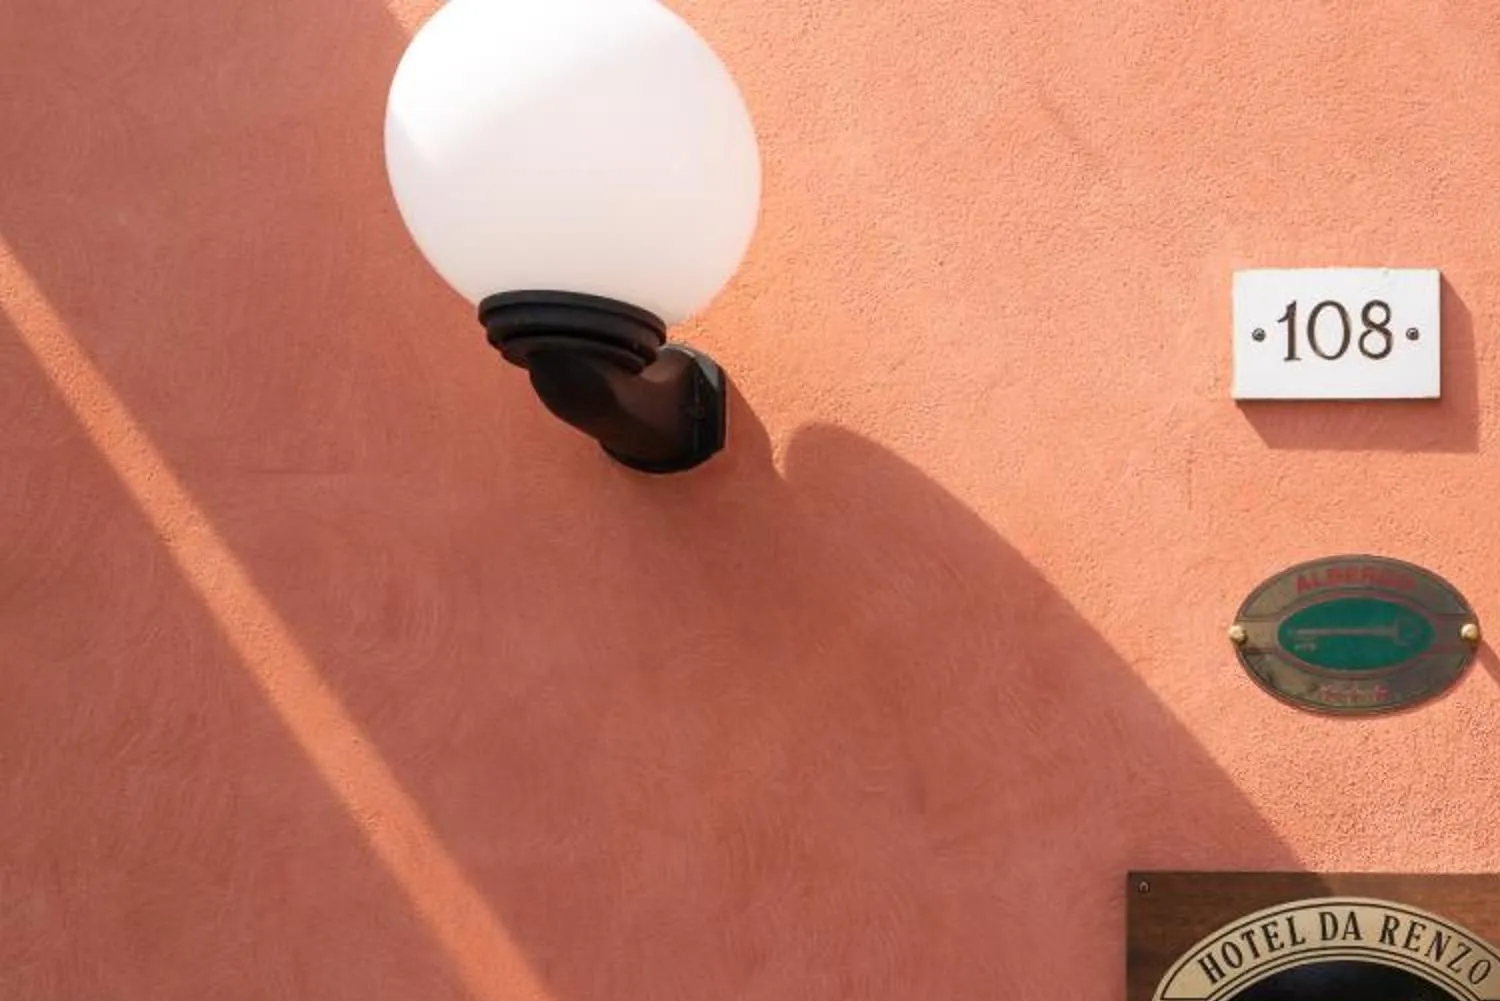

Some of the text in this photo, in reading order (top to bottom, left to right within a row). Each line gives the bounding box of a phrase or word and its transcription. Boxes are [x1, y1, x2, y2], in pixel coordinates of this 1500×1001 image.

[1276, 298, 1394, 362] 108
[1197, 910, 1493, 986] HOTEL DA RENZO
